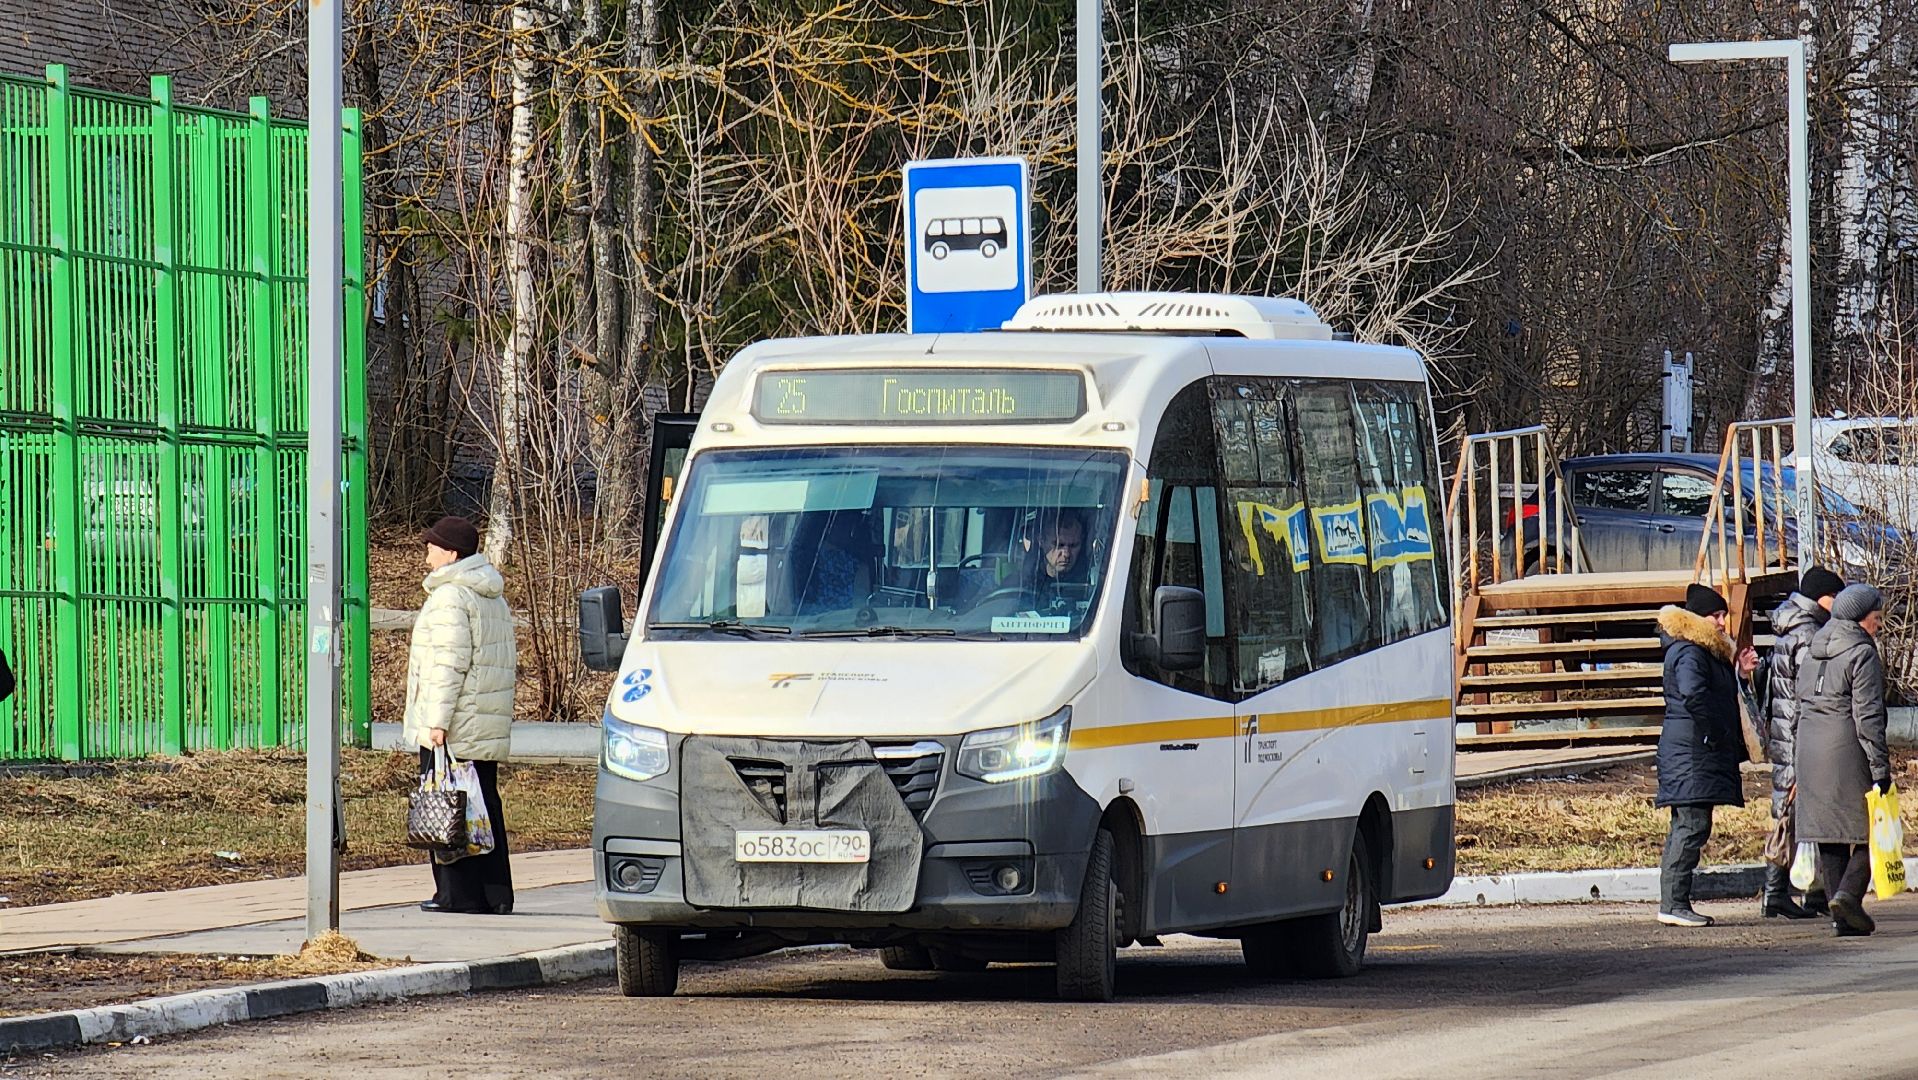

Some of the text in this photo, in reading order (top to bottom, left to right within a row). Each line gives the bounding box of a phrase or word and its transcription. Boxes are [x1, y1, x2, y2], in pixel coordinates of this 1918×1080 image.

[776, 377, 1015, 414] 25 Госпиталь
[831, 835, 862, 852] 790
